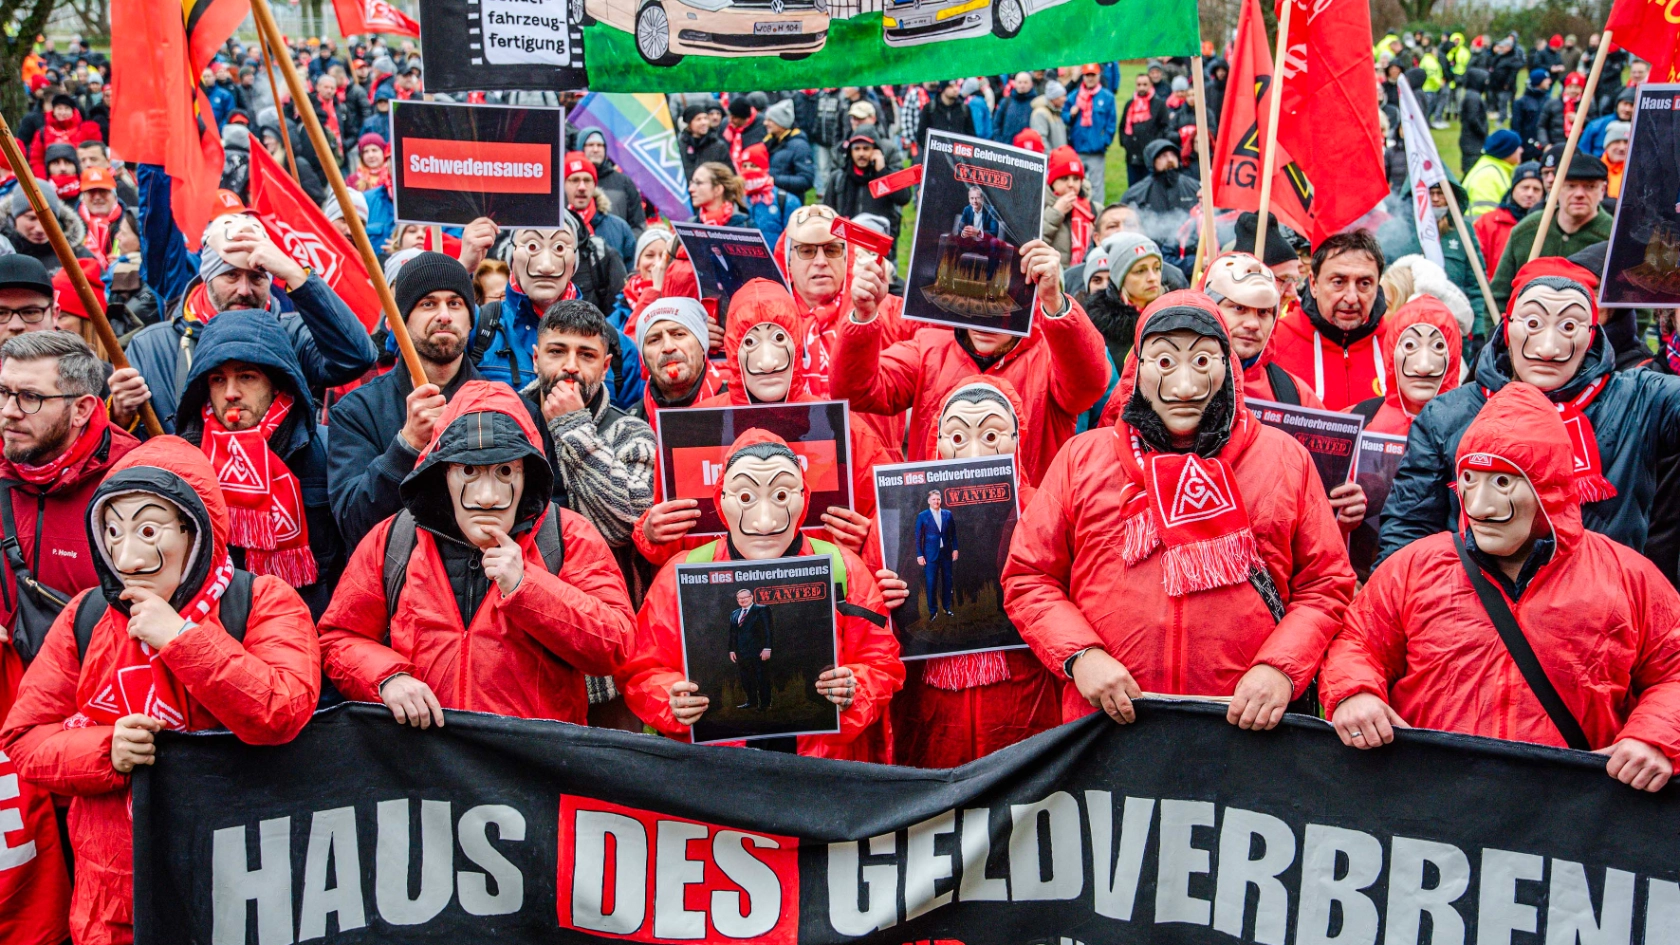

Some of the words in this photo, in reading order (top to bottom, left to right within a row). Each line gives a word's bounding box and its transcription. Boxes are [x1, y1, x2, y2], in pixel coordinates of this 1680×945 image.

[488, 10, 565, 31] fahrzeug-
[786, 24, 799, 32] 104
[489, 33, 565, 54] fertigung
[1641, 97, 1672, 110] Haus
[410, 154, 543, 178] Schwedensause
[930, 139, 953, 154] Haus
[955, 145, 972, 156] des
[973, 148, 1044, 173] Geldverbrennens
[959, 167, 1008, 187] WANTED
[1226, 158, 1257, 189] IG
[1264, 412, 1282, 423] des
[1283, 414, 1359, 434] Geldverbrennens
[1361, 440, 1384, 453] Haus
[1385, 444, 1403, 454] des
[878, 475, 904, 487] Haus
[905, 473, 924, 485] des
[926, 465, 1012, 483] Geldverbrennens
[948, 486, 1007, 503] WANTED
[680, 573, 709, 585] Haus
[711, 571, 732, 583] des
[734, 565, 829, 582] Geldverbrennens
[758, 584, 821, 602] WANTED
[213, 799, 526, 945] HAUS
[572, 809, 782, 940] DES
